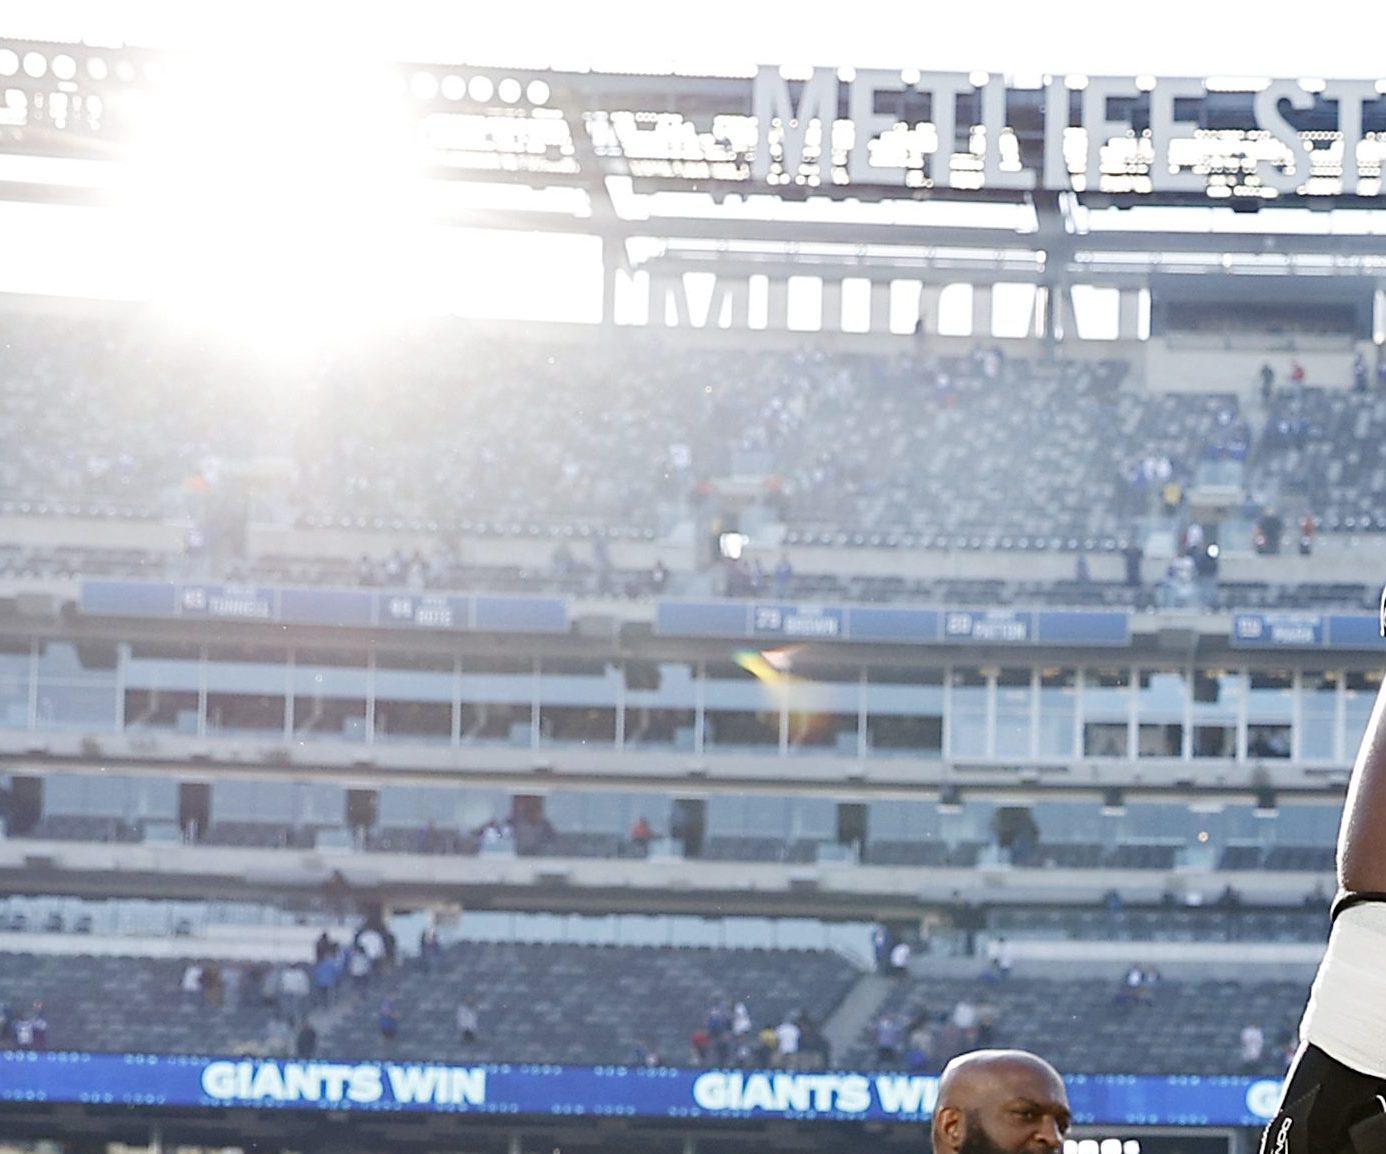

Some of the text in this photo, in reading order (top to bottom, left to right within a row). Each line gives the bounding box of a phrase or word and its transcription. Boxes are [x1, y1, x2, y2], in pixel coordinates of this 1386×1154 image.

[753, 65, 1207, 193] METLIFE
[201, 1061, 486, 1105] GIANTS WIN
[694, 1071, 940, 1114] GIANTS WI
